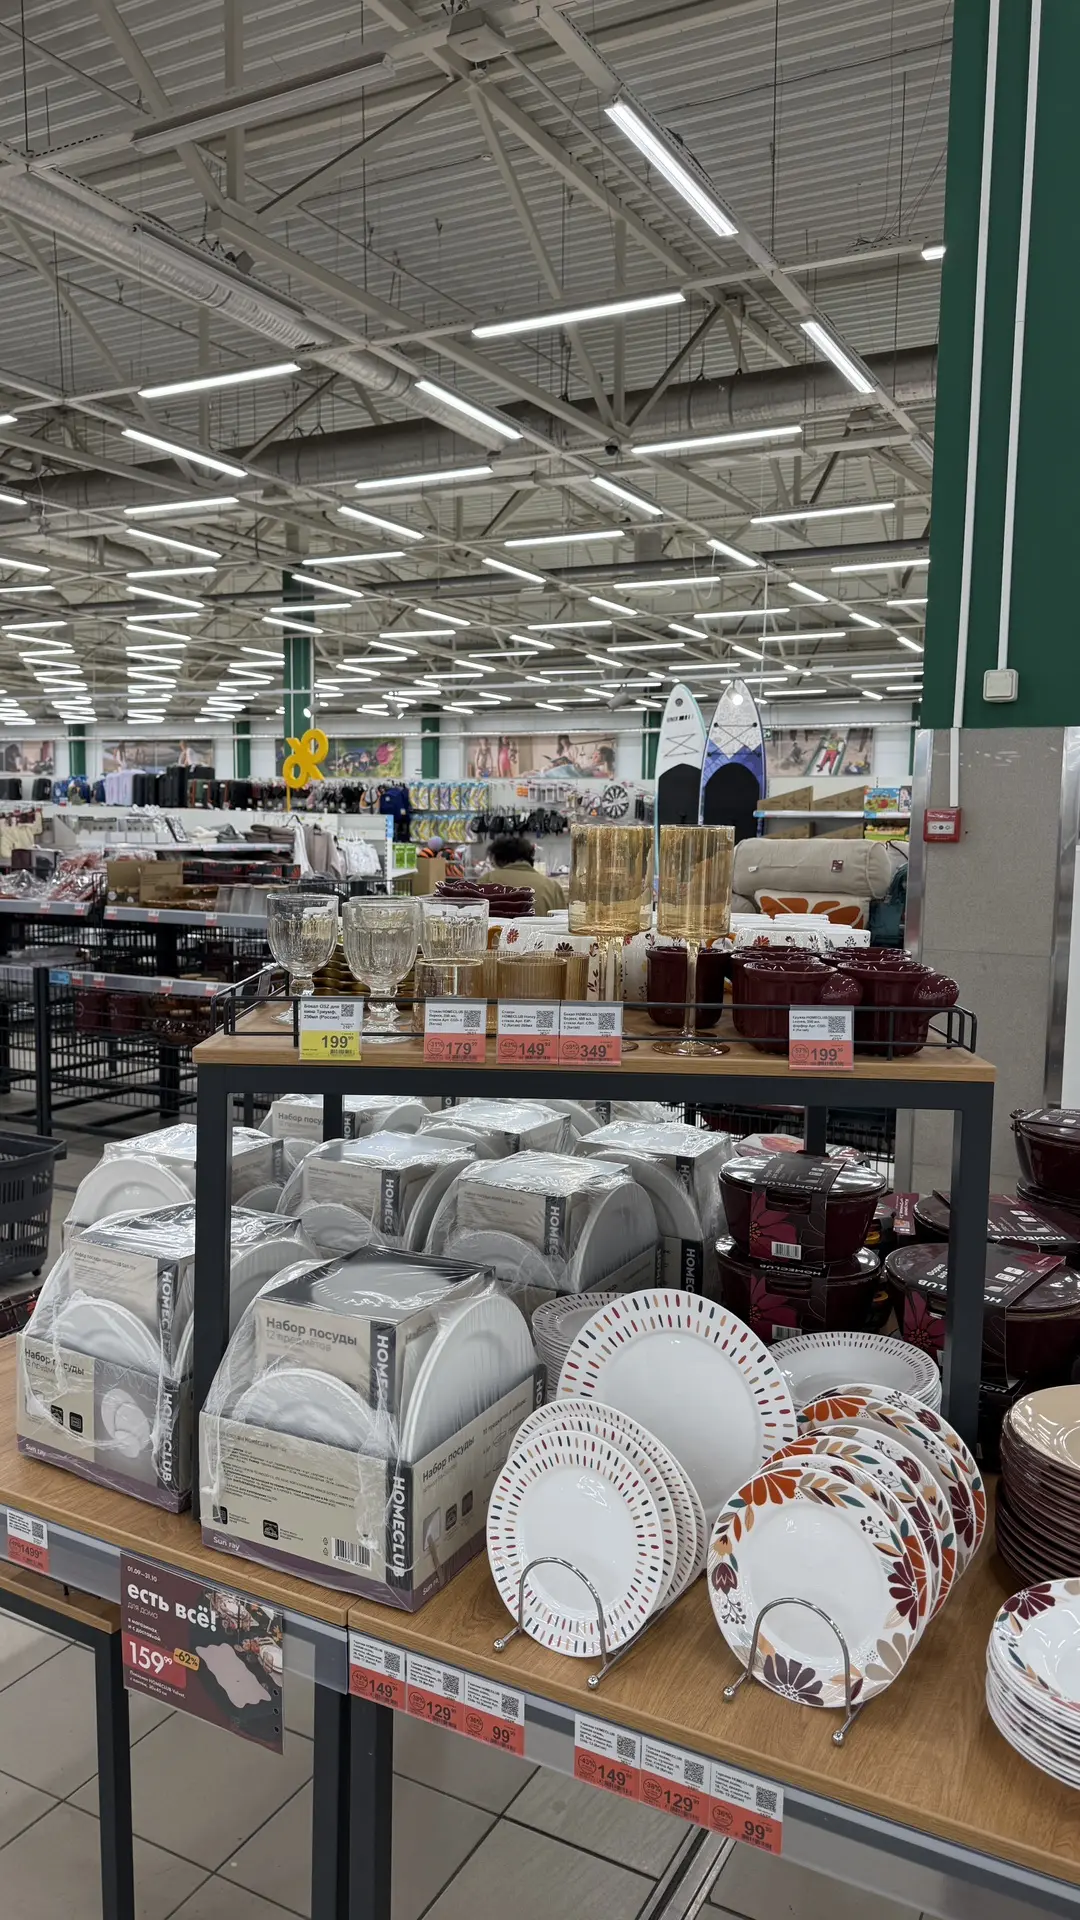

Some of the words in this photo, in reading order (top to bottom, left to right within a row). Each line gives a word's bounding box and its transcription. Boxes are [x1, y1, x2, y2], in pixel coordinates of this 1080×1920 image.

[278, 1112, 302, 1122] Набор
[304, 1116, 324, 1125] посу
[760, 1180, 821, 1190] HOMECLUB
[384, 1179, 394, 1229] HOMEC
[549, 1206, 559, 1256] HOMEC
[686, 1248, 695, 1294] HOMEC
[760, 1264, 821, 1276] HOMECLUB
[266, 1317, 306, 1334] Набор
[310, 1328, 357, 1346] посуды
[277, 1334, 332, 1352] предметов
[25, 1348, 50, 1365] Набор
[422, 1457, 446, 1482] Набор
[448, 1436, 474, 1464] посуды
[392, 1476, 405, 1577] HOMECLUB
[213, 1536, 228, 1546] Sun
[228, 1542, 240, 1551] ray
[128, 1584, 170, 1612] есть
[176, 1604, 216, 1632] всё!
[175, 1652, 198, 1666] -62%
